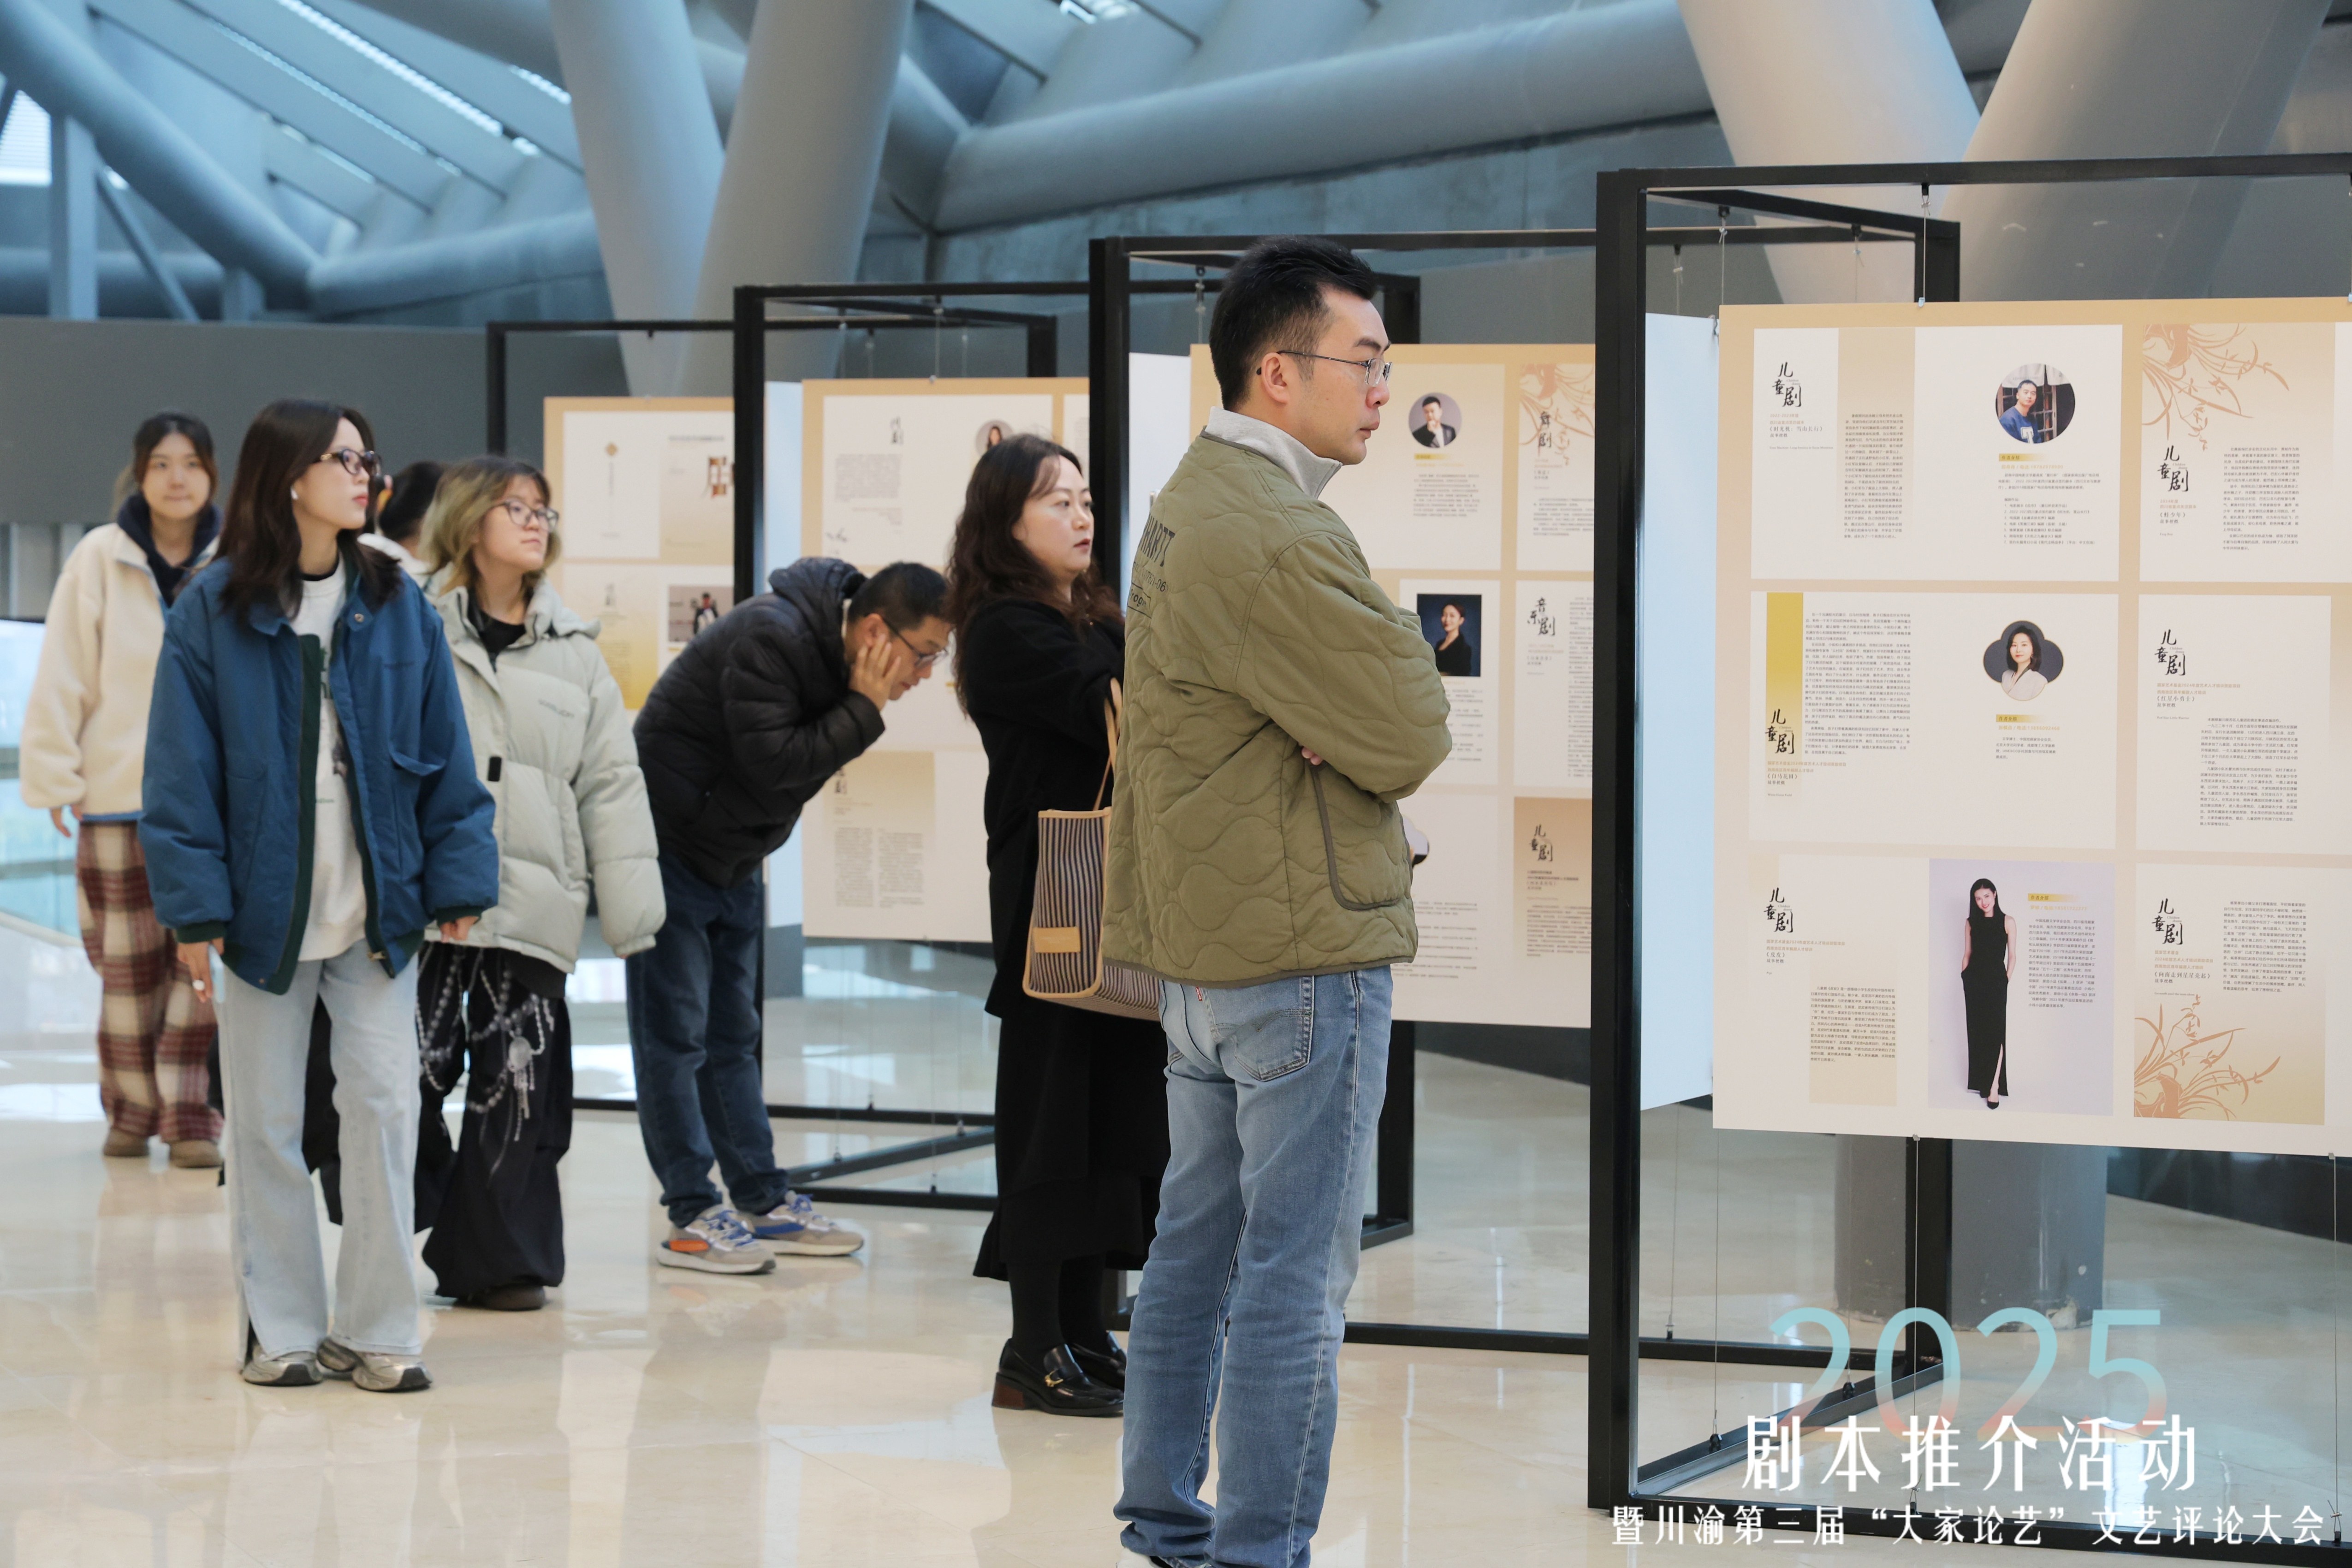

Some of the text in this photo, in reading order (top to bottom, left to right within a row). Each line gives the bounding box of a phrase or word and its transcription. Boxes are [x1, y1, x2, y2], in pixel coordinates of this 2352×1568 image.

[1772, 362, 1801, 407] 儿童剧
[2157, 445, 2188, 492] 儿童剧
[2155, 629, 2186, 676] 儿童剧
[1765, 708, 1794, 754] 儿童剧
[1764, 887, 1793, 932] 儿童剧
[2152, 898, 2183, 944] 儿童剧
